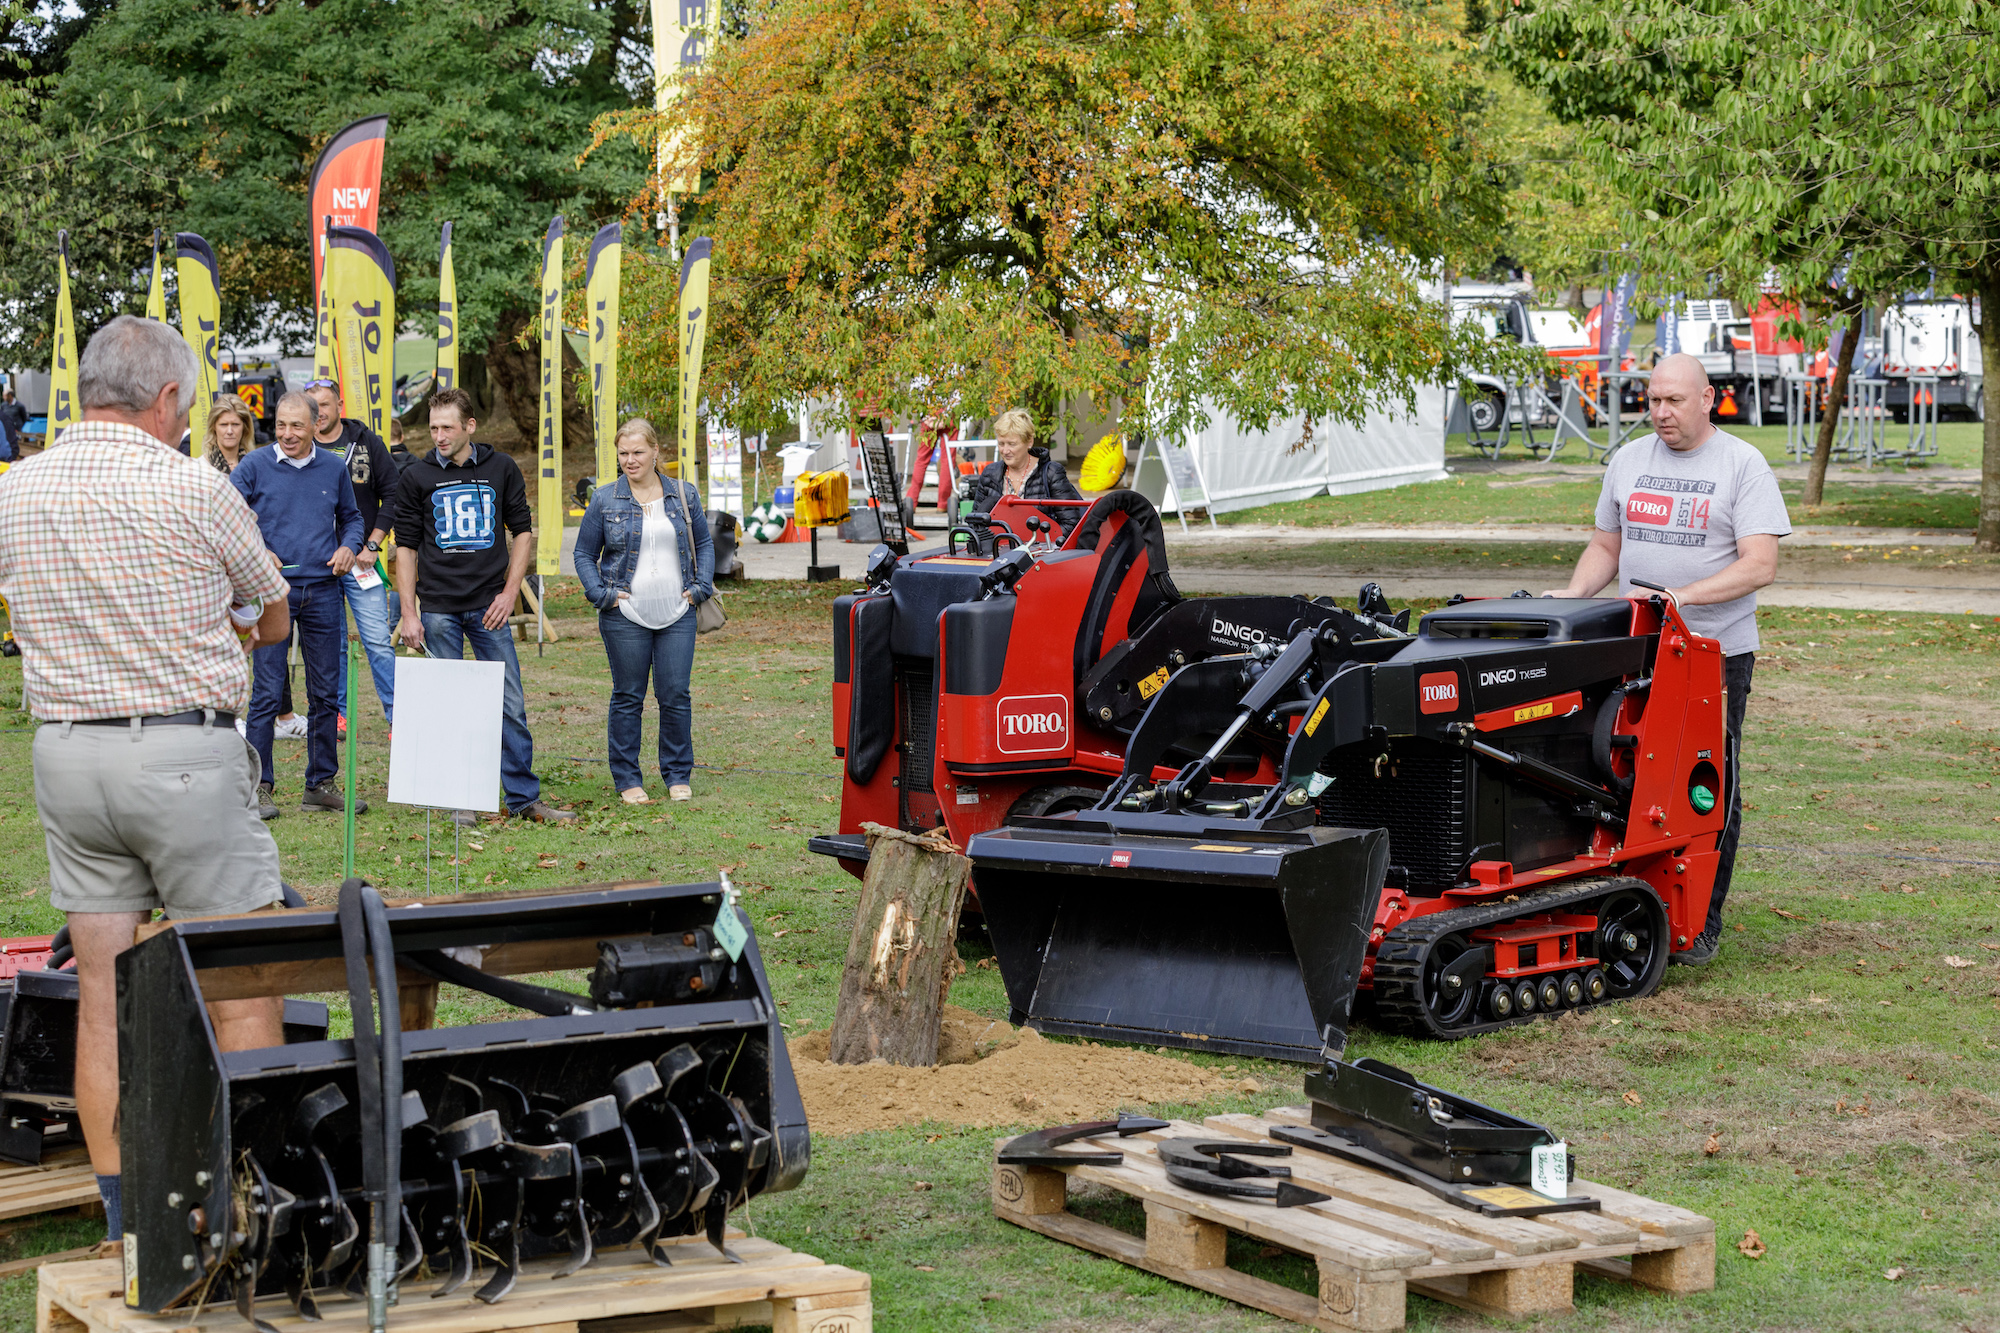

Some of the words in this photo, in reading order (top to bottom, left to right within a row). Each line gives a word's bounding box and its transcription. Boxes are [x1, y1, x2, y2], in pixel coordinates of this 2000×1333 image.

[333, 187, 371, 210] NEW
[353, 300, 381, 355] JO
[347, 320, 360, 377] Professional
[352, 379, 363, 412] garden
[1697, 480, 1713, 494] OF
[1629, 500, 1667, 517] TORO
[1688, 497, 1710, 530] 14
[1641, 529, 1661, 543] TORO
[1662, 531, 1704, 547] COMPANY
[1210, 635, 1240, 648] NARROW
[1212, 618, 1264, 644] DINGO
[1480, 668, 1517, 687] DINGO
[1422, 683, 1456, 702] TORO
[1003, 712, 1063, 736] TORO
[1112, 854, 1130, 864] TORO
